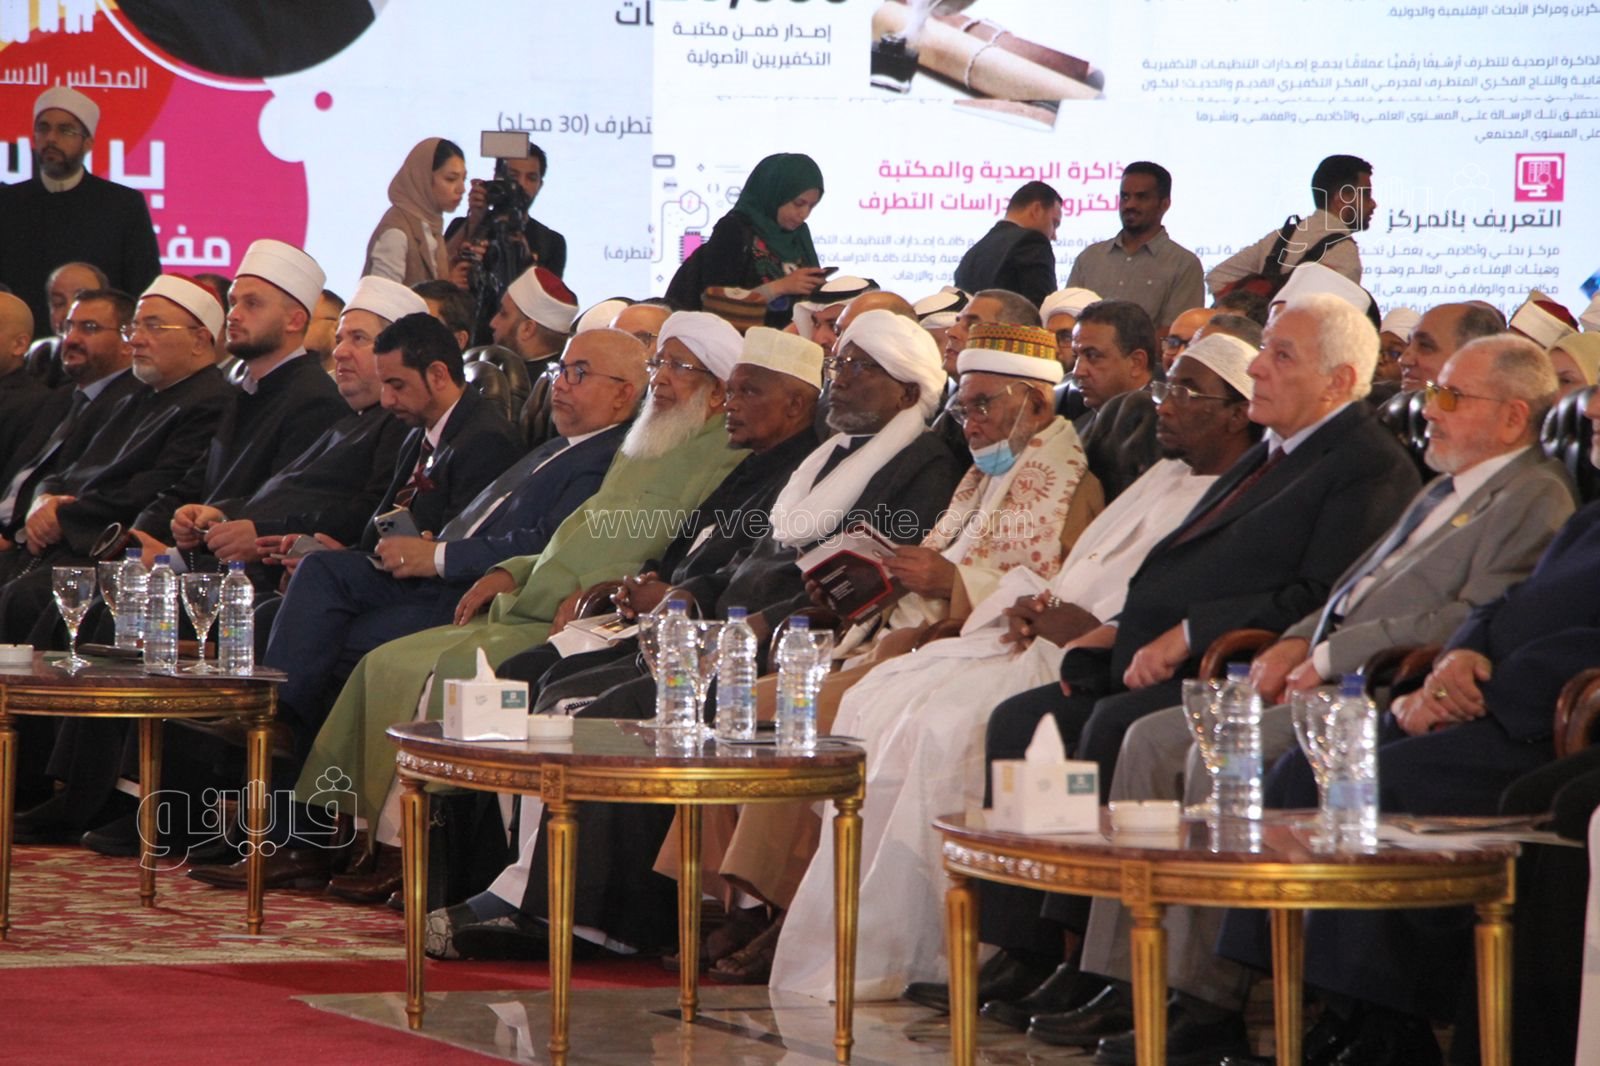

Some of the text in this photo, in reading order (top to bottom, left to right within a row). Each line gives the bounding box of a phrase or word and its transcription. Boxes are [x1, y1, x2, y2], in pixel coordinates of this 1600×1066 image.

[672, 20, 832, 44] إصدار ضمن مكتبة
[687, 47, 832, 70] التكفيريين الأصولية
[1142, 58, 1197, 72] التكفيرية
[1200, 58, 1259, 72] التنظيمات
[1261, 58, 1307, 72] إصدارات
[54, 64, 148, 92] المجلس
[1335, 77, 1368, 91] الفكر
[877, 159, 974, 185] والمكتبة
[979, 159, 1060, 184] الرصدية
[858, 191, 934, 216] التطرف
[1386, 208, 1562, 234] التعريف بالمركز
